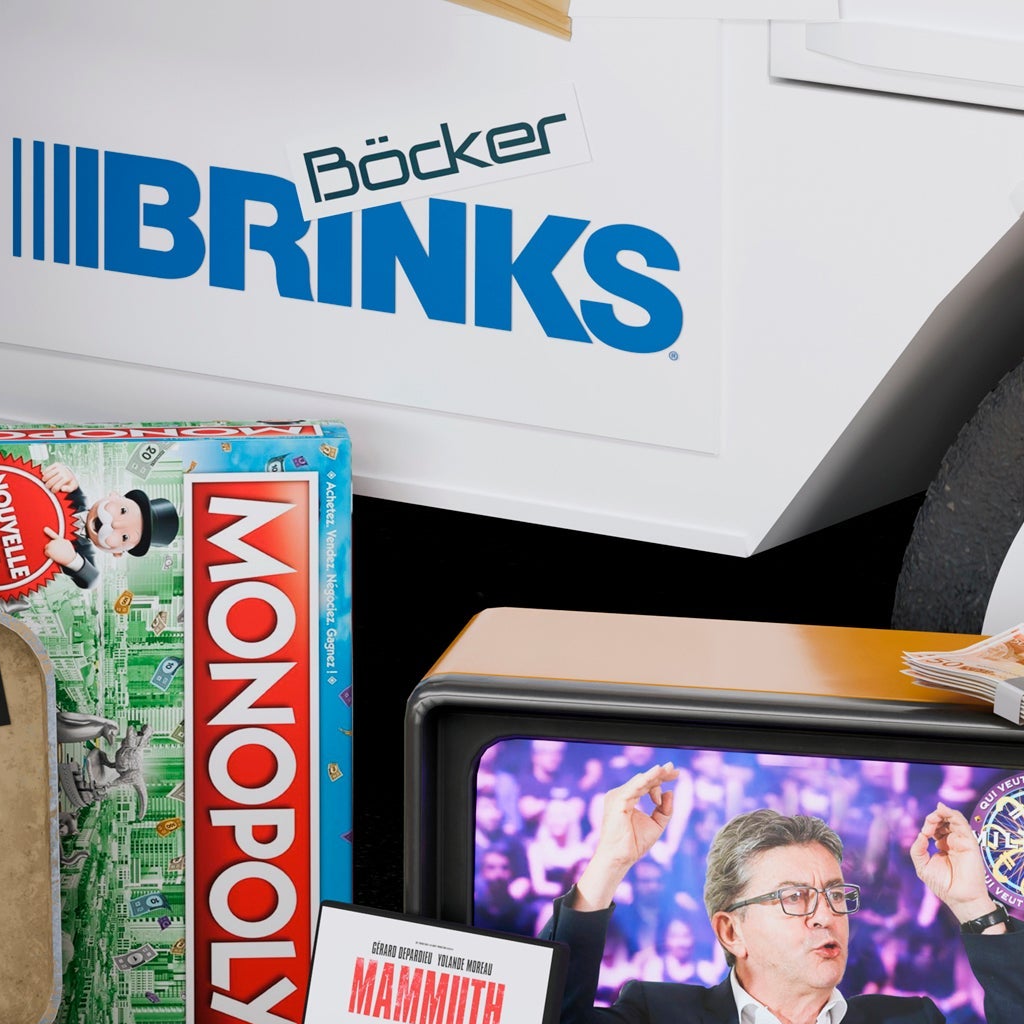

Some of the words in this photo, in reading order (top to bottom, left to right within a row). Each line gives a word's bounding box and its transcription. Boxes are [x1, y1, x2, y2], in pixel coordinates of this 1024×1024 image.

[303, 112, 567, 203] Böcker
[104, 150, 684, 354] BRINKS
[324, 630, 338, 667] Gagnez
[980, 791, 998, 810] QUI
[995, 886, 1024, 907] VEUT
[371, 940, 397, 958] GÉRARD
[398, 947, 433, 965] DEPARDIEU
[437, 954, 465, 971] YOLANDE
[466, 959, 493, 976] MOREAU
